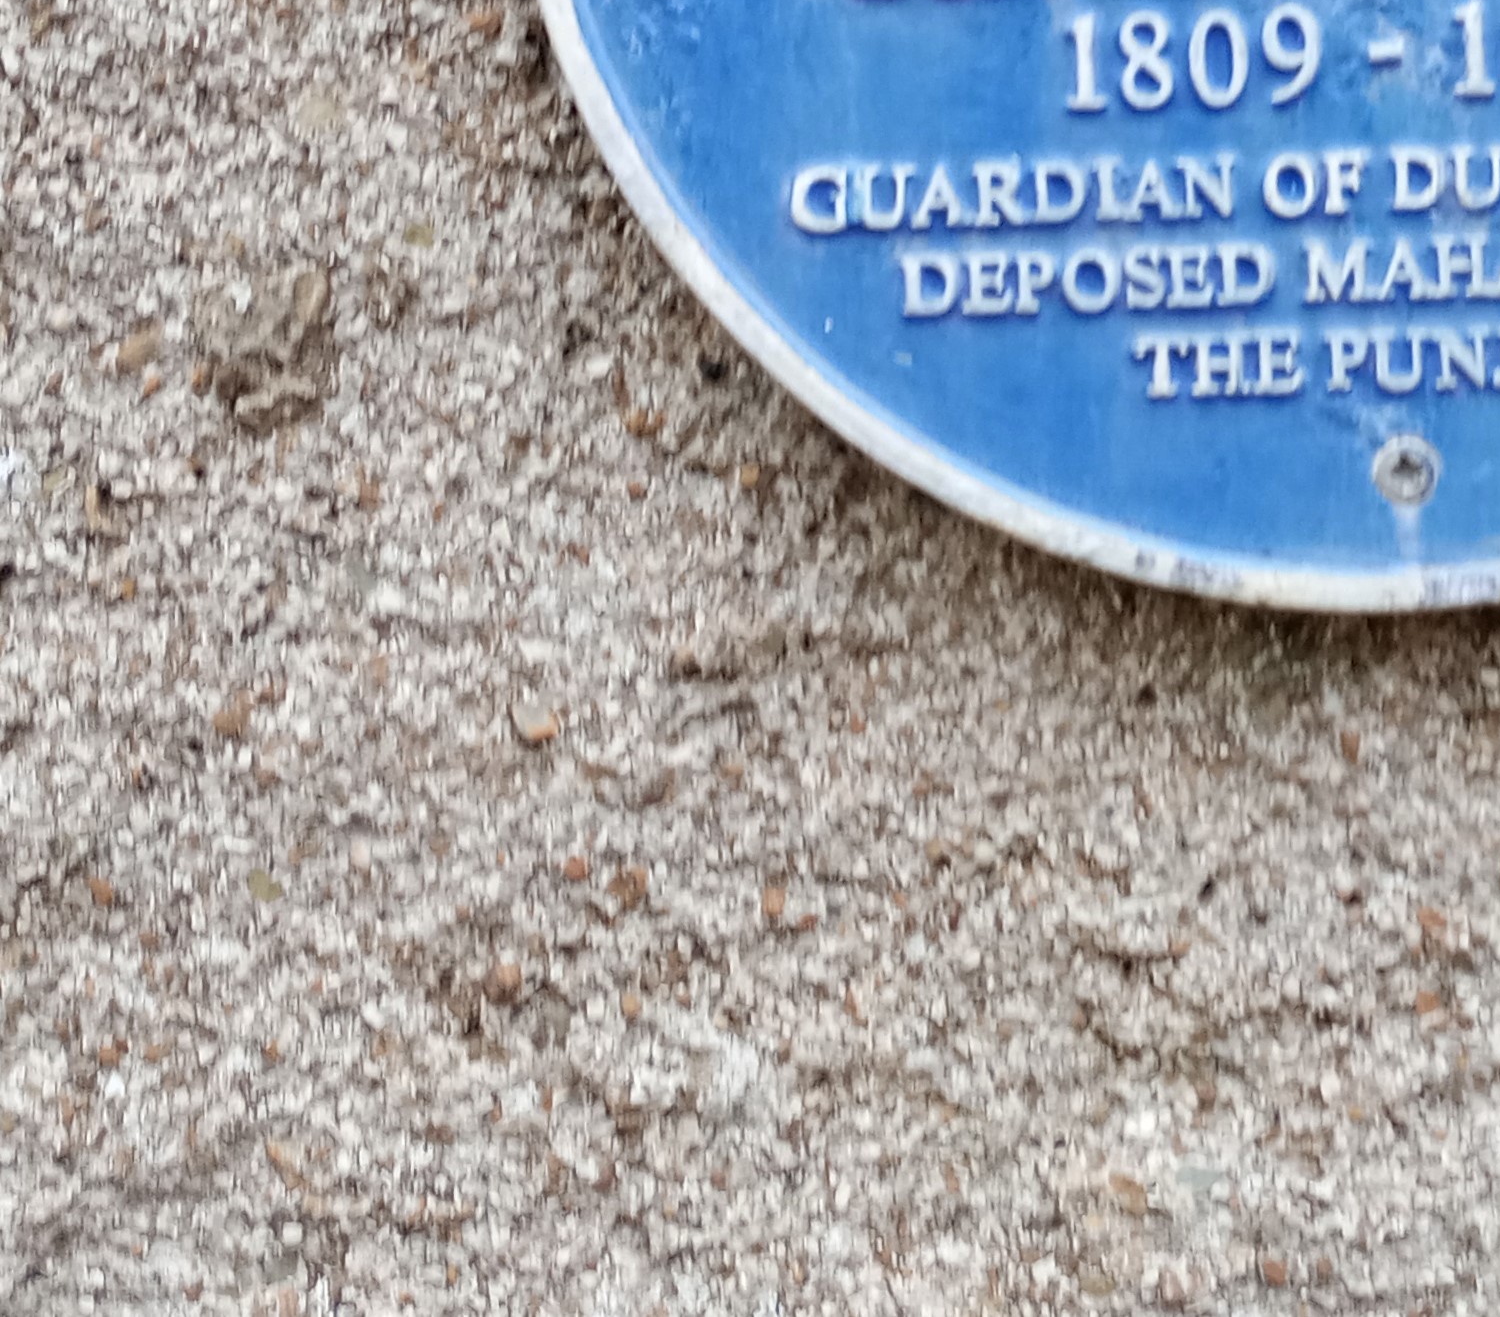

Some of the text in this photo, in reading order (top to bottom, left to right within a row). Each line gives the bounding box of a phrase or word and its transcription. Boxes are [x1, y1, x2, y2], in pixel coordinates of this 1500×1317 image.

[1064, 2, 1321, 112] 1809
[1367, 36, 1405, 64] -
[789, 152, 1236, 233] GUARDIAN
[1262, 149, 1370, 217] OF
[901, 242, 1274, 317] DEPOSED
[1133, 328, 1303, 399] THE
